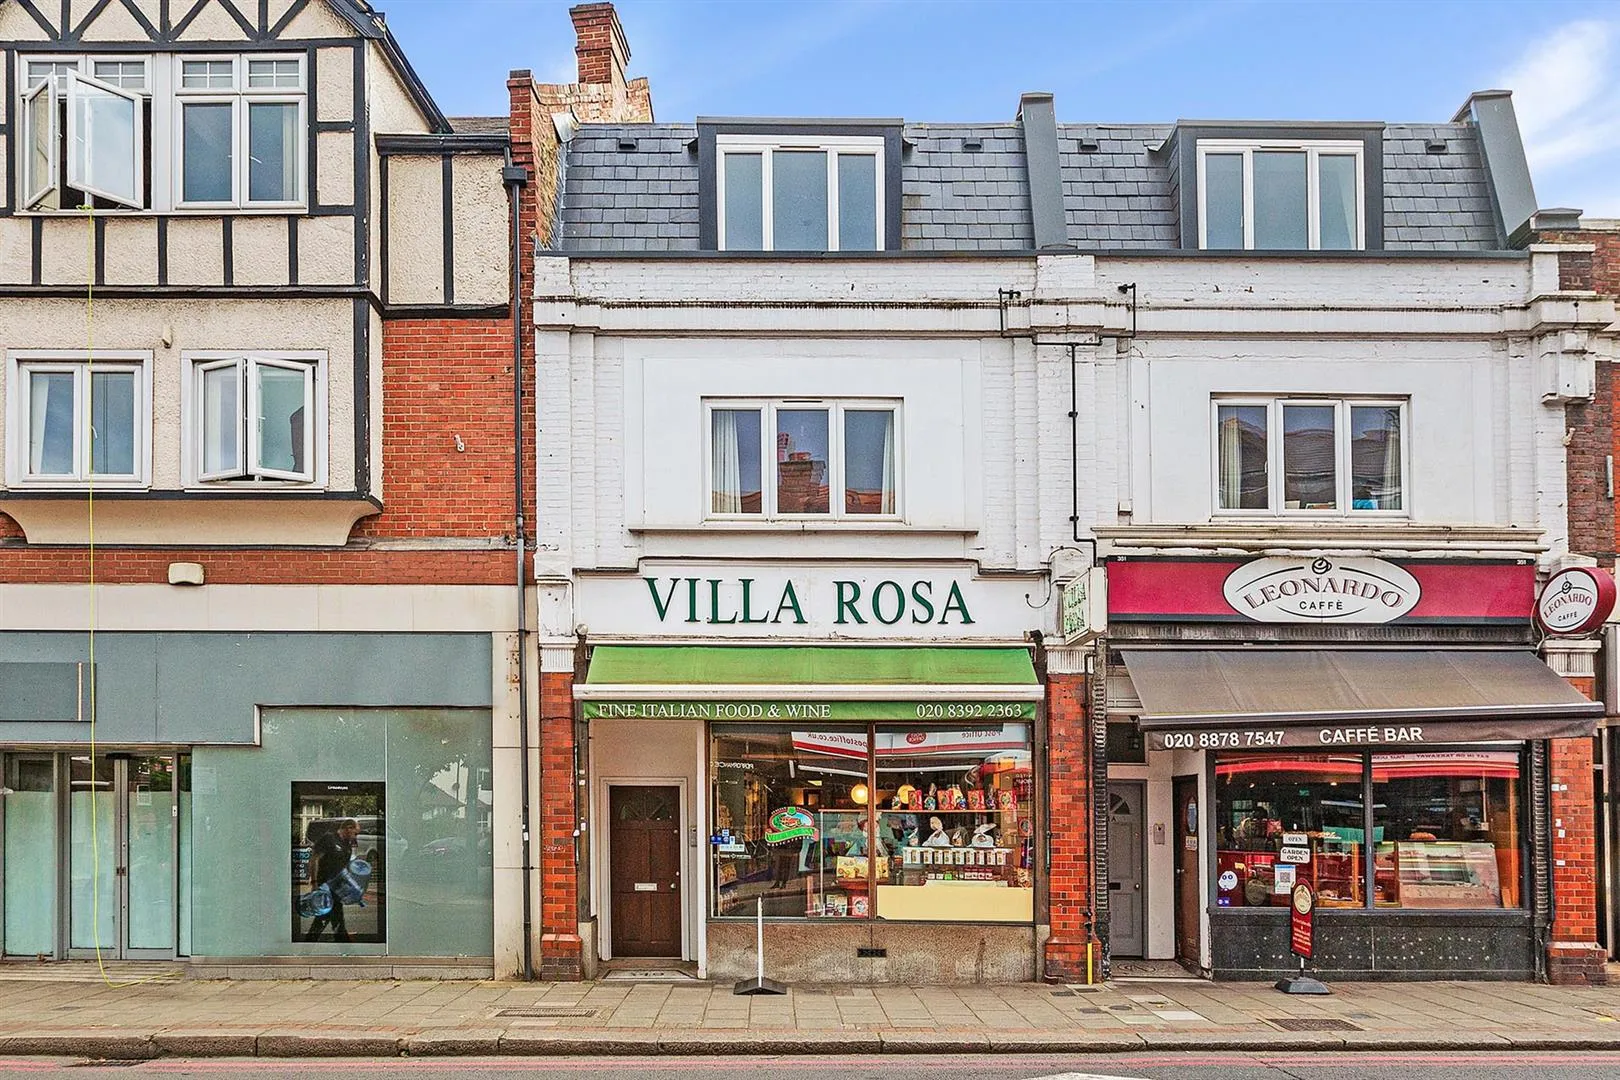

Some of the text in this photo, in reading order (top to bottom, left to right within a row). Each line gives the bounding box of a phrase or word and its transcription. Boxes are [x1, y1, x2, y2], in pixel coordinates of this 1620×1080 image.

[643, 577, 976, 625] VILLA ROSA
[1243, 577, 1404, 609] LEONARDO
[1543, 593, 1593, 619] LEONARDO
[599, 704, 832, 718] FINE ITALIAN FOOD & WINE
[916, 704, 1022, 717] 020 8392 2363
[1164, 731, 1285, 748] 020 8878 7547
[1319, 726, 1424, 744] CAFFÉ BAR
